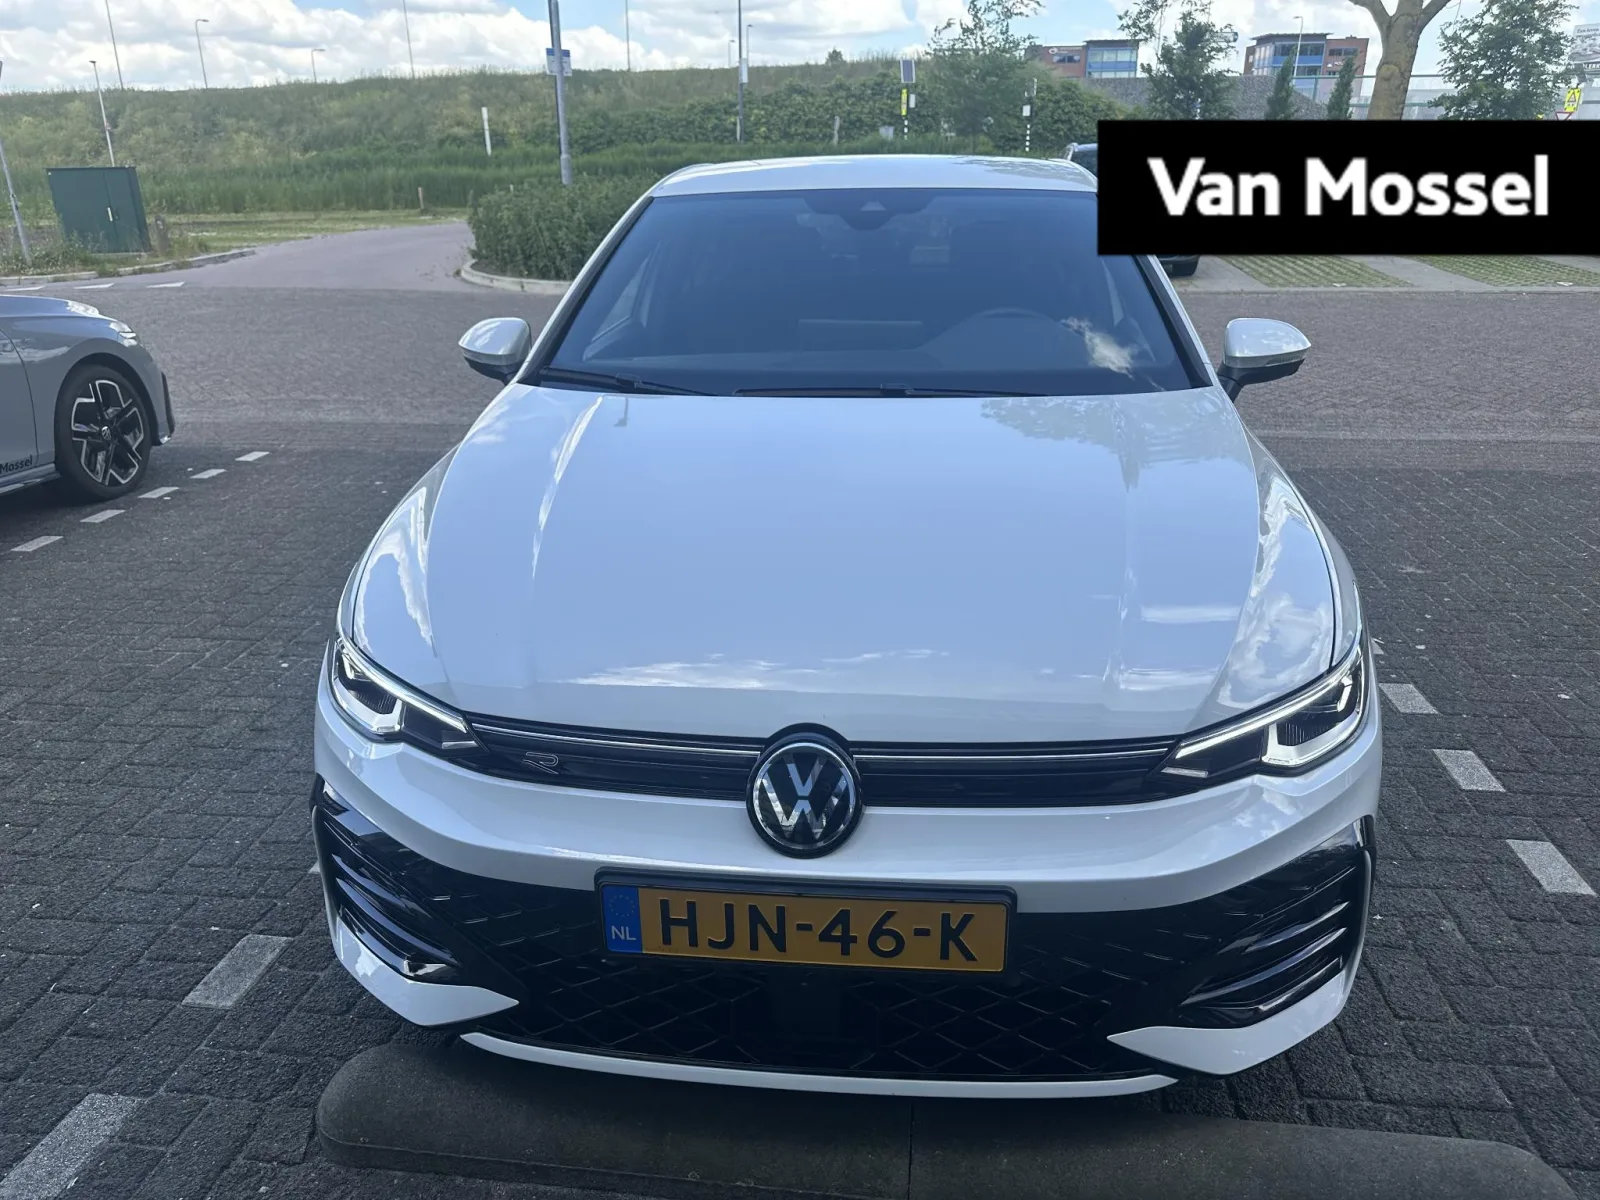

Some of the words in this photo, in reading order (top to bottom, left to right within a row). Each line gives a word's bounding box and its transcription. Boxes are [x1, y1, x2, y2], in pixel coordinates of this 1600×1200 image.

[0, 454, 33, 474] Mossel
[753, 742, 856, 850] VW
[610, 925, 637, 942] NL
[659, 898, 979, 962] HJN-46-K
